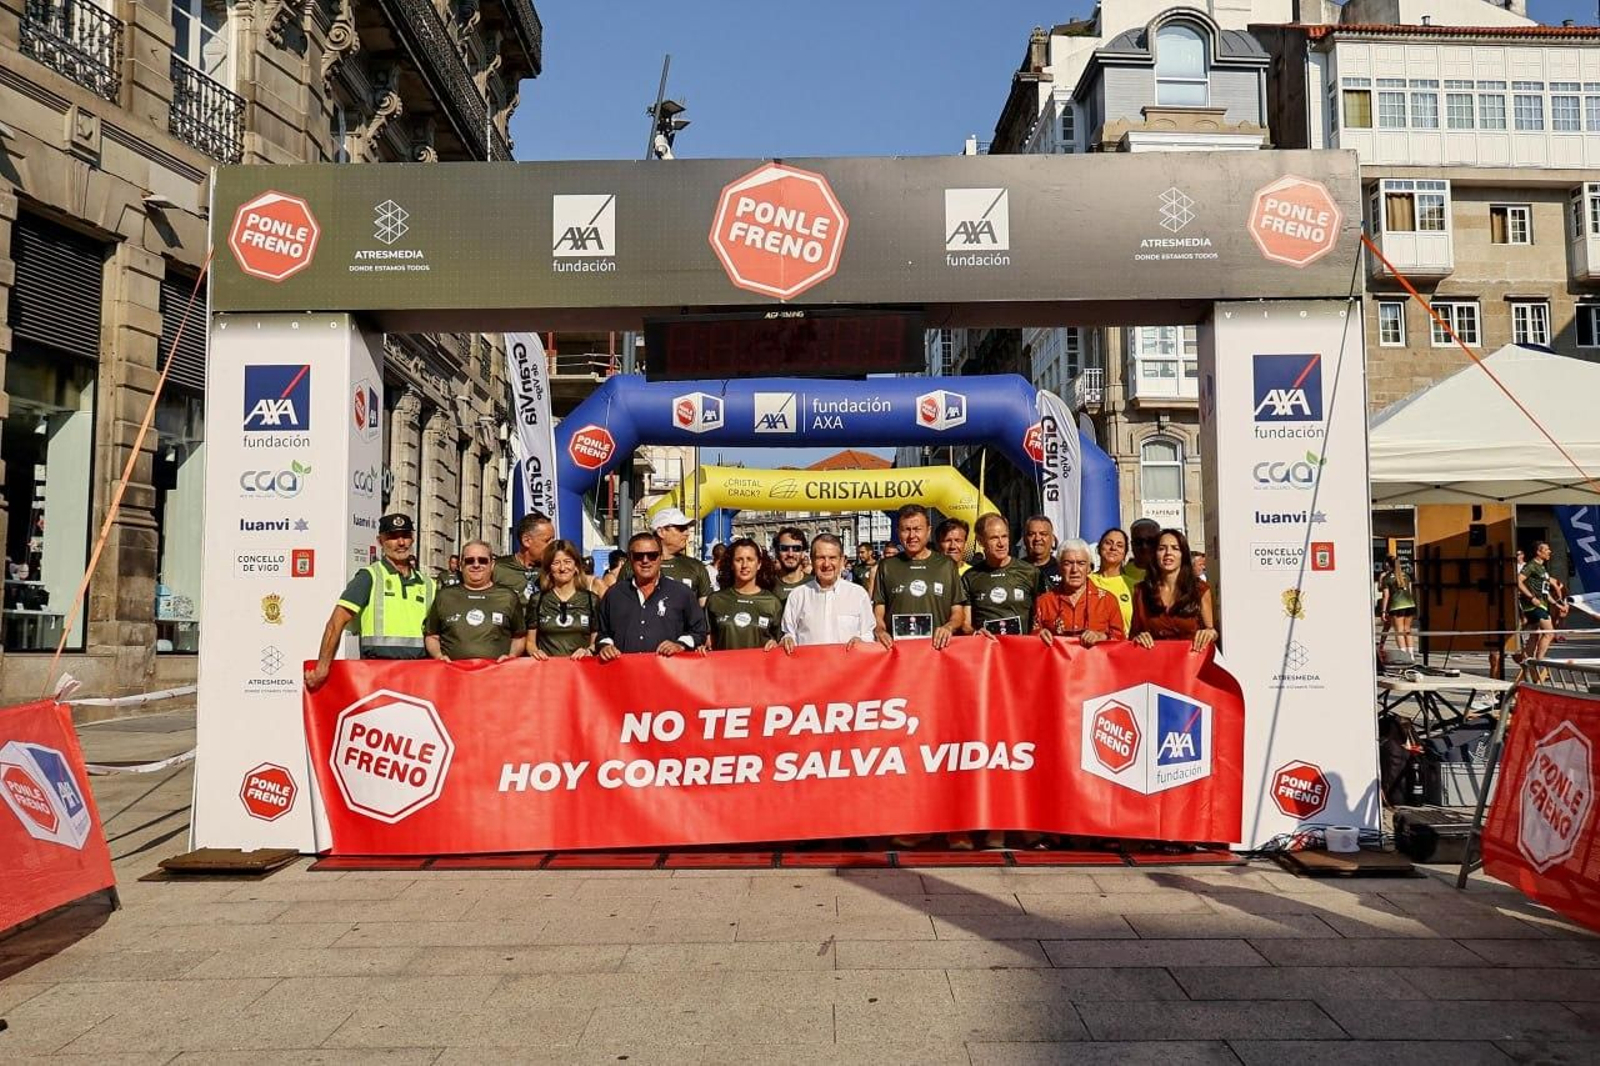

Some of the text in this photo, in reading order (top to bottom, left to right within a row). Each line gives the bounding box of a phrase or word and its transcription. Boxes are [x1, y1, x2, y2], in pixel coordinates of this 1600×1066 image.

[736, 197, 831, 239] PONLE
[1264, 198, 1331, 227] PONLE
[246, 213, 309, 242] PONLE
[946, 220, 998, 245] AXA
[1259, 214, 1325, 243] FRENO
[240, 230, 304, 259] FRENO
[553, 226, 605, 251] AXA
[729, 221, 823, 264] FRENO
[1140, 238, 1212, 248] ATRESMEDIA
[354, 250, 424, 259] ATRESMEDIA
[946, 253, 1010, 266] fundación
[1195, 252, 1218, 260] TODOS
[553, 258, 616, 272] fundación
[244, 399, 299, 425] AXA
[812, 397, 891, 413] fundación
[1254, 389, 1312, 416] AXA
[755, 413, 789, 430] AXA
[812, 416, 844, 430] AXA
[244, 434, 310, 448] fundación
[1254, 425, 1325, 439] fundación
[574, 443, 607, 460] FRENO
[577, 435, 611, 452] PONLE
[723, 478, 763, 487] ¿CRISTAL
[728, 488, 761, 497] CRACK?
[805, 479, 924, 499] CRISTALBOX
[240, 518, 290, 531] luanvi
[1255, 511, 1307, 523] luanvi
[238, 555, 285, 563] CONCELLO
[1254, 548, 1304, 556] CONCELLO
[1260, 557, 1298, 565] DE VIGO
[243, 564, 280, 572] DE VIGO
[619, 697, 920, 744] NO TE PARES,
[1097, 716, 1134, 745] PONLE
[350, 722, 436, 765] PONLE
[1094, 729, 1130, 757] FRENO
[1157, 731, 1195, 760] AXA
[344, 746, 428, 788] FRENO
[498, 741, 1036, 792] HOY CORRER SALVA VIDAS
[1157, 764, 1202, 785] fundación
[250, 776, 291, 797] PONLE
[1281, 774, 1323, 795] PONLE
[247, 787, 287, 807] FRENO
[1278, 785, 1320, 806] FRENO
